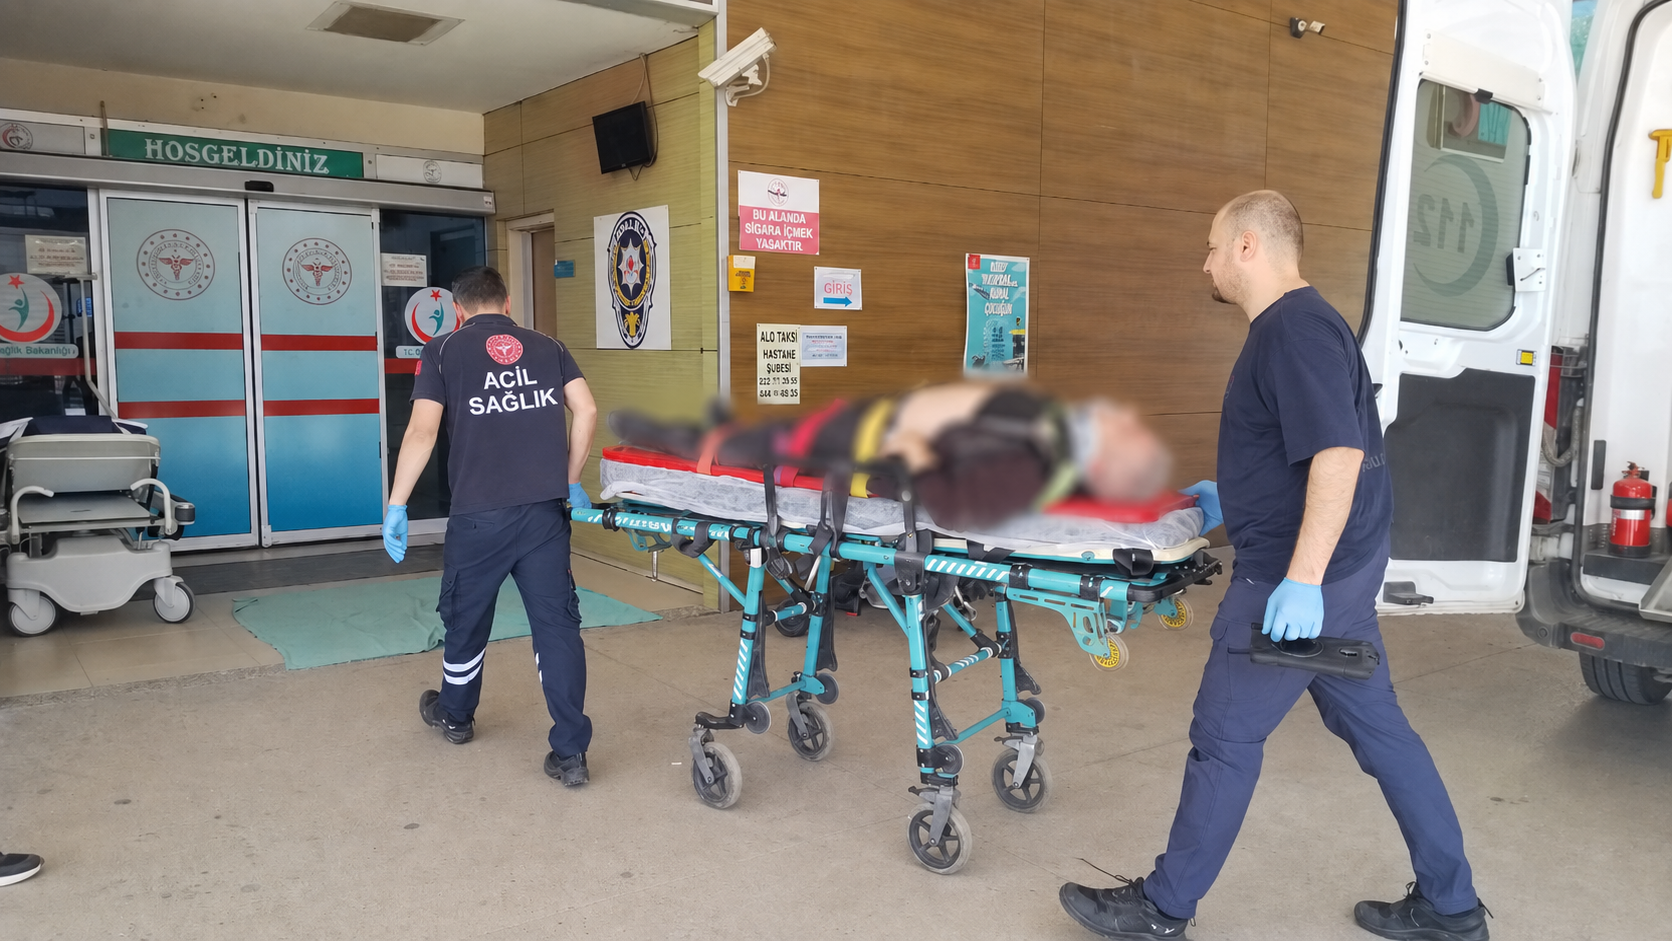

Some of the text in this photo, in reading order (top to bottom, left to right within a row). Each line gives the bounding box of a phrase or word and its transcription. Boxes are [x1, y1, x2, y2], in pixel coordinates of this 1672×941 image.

[753, 208, 806, 224] BU ALANDA
[745, 221, 813, 239] SİGARA İÇMEK
[756, 237, 803, 251] YASAKTIR
[824, 280, 853, 297] GİRİŞ
[760, 329, 798, 343] ALO TAKSİ
[766, 362, 792, 374] ŞUBESİ
[483, 365, 538, 390] ACİL
[468, 387, 559, 415] SAĞLIK
